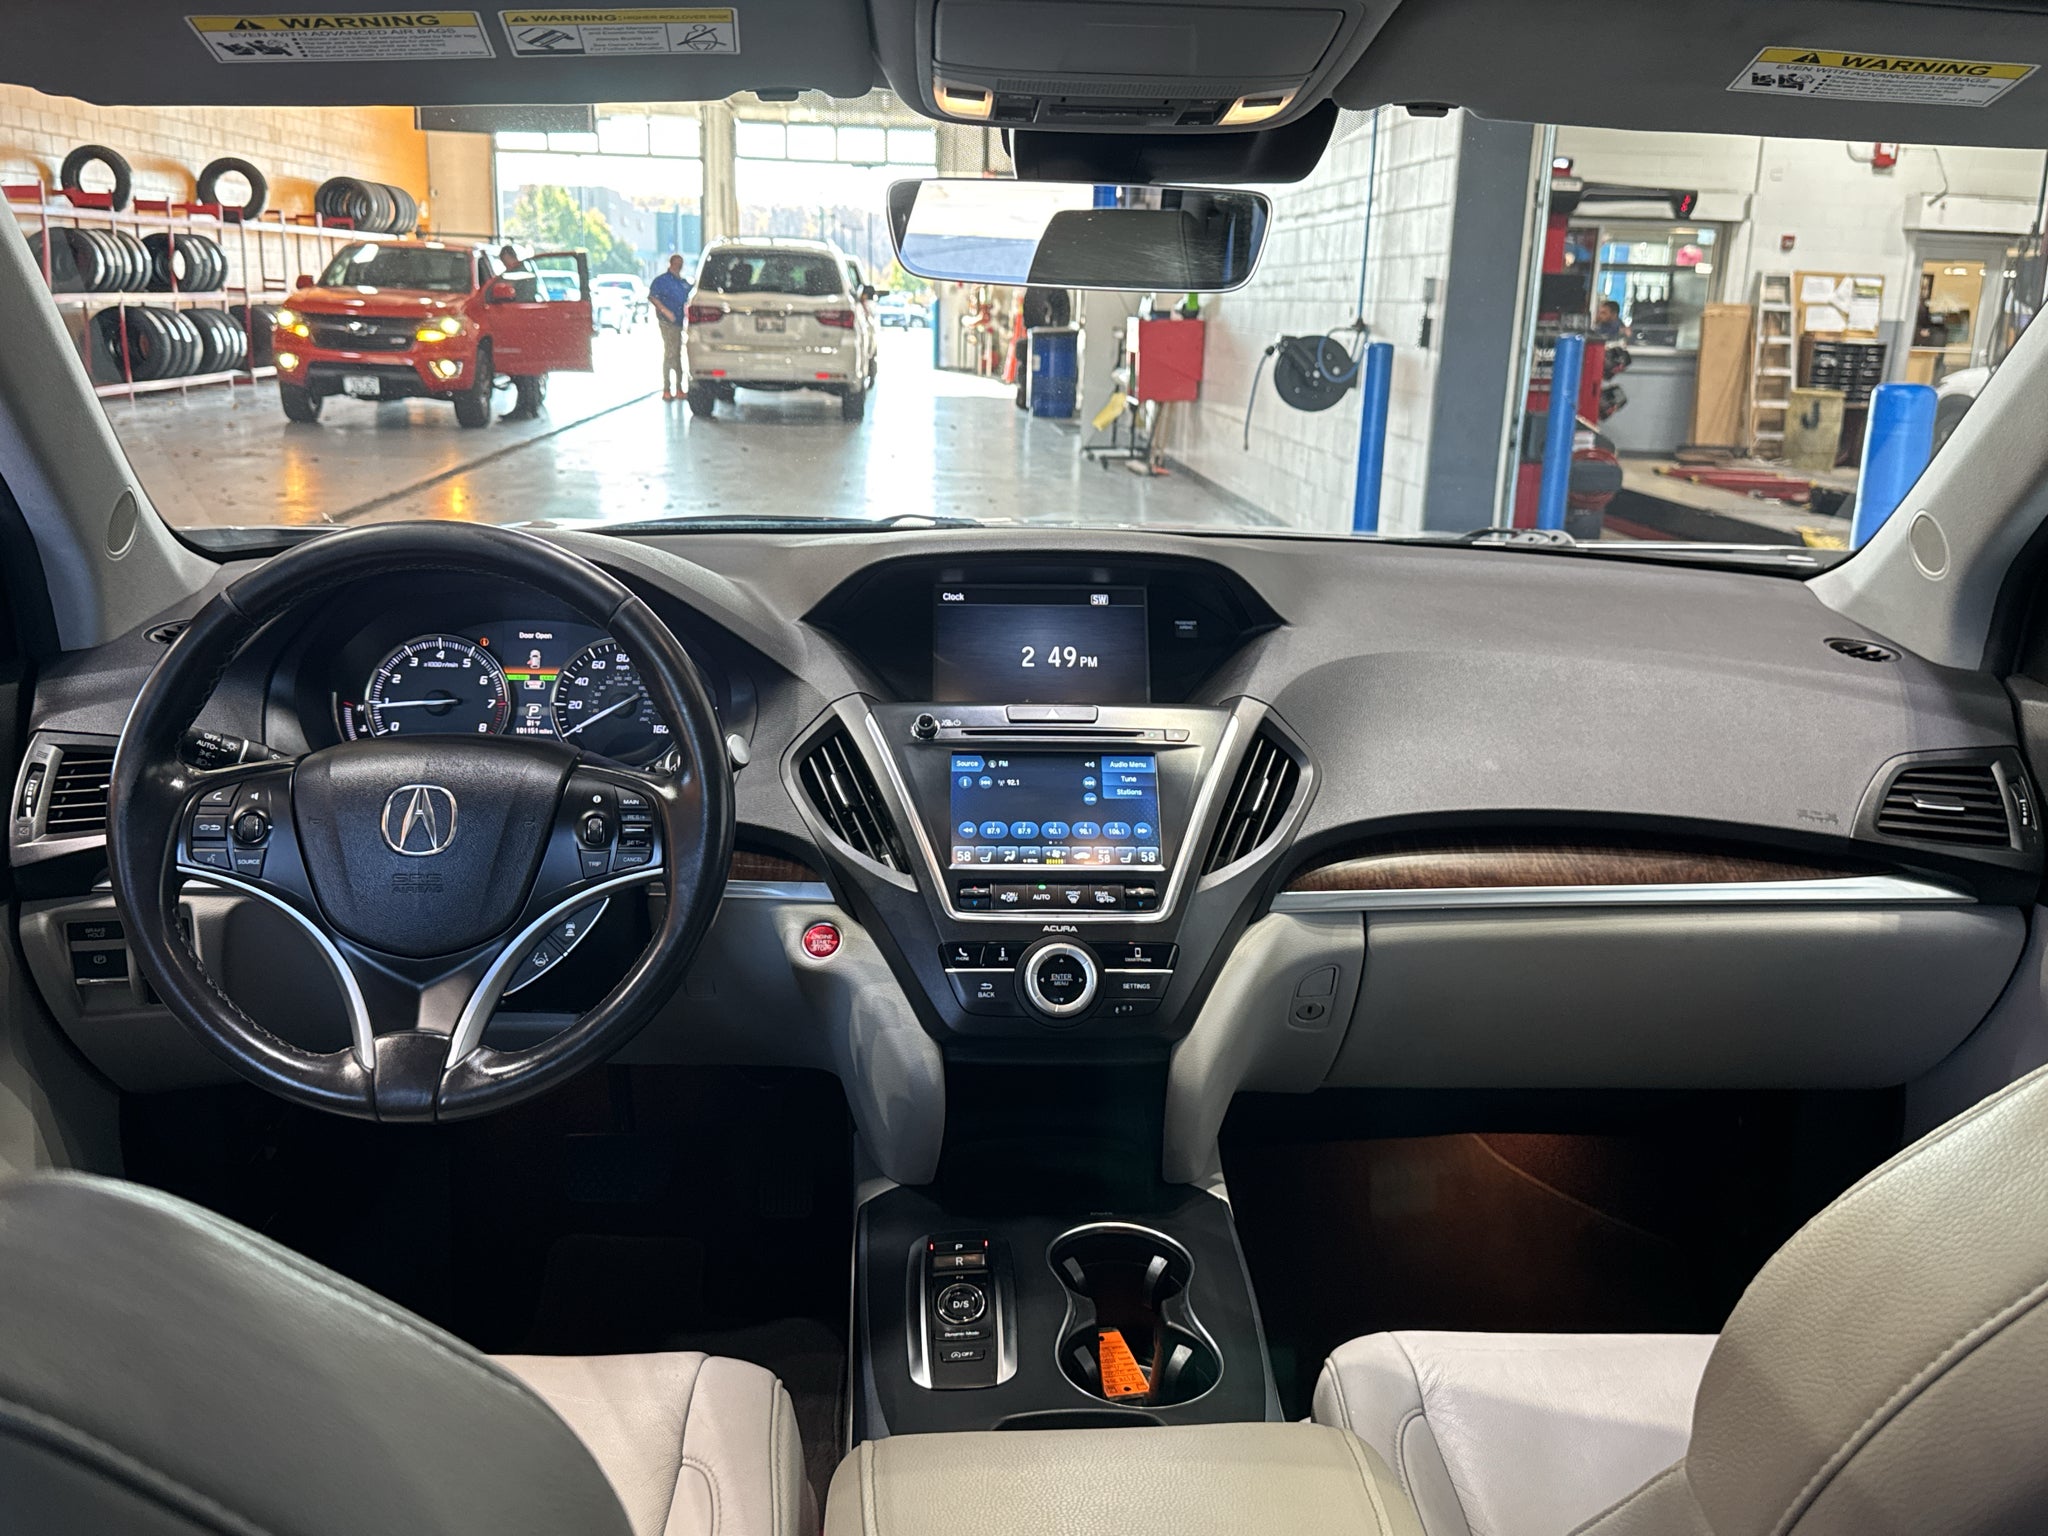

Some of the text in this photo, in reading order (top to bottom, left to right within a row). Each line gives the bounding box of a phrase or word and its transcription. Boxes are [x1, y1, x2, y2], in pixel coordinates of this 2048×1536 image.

[279, 15, 440, 29] WARNING
[311, 29, 387, 37] ADVANCED
[1842, 56, 1992, 76] WARNING
[1850, 70, 1925, 80] ADVANCED
[942, 592, 965, 601] Clock
[535, 632, 552, 640] Open
[436, 650, 445, 659] 4
[1021, 646, 1098, 667] 2 49 PM
[409, 657, 419, 667] 3
[462, 658, 471, 668] 5
[592, 660, 606, 669] 60
[391, 674, 401, 684] 2
[479, 675, 488, 685] 6
[575, 677, 589, 686] 40
[356, 704, 364, 712] H
[487, 699, 496, 709] 7
[568, 700, 582, 709] 20
[528, 706, 539, 716] P
[390, 722, 400, 731] 0
[478, 723, 487, 732] 8
[204, 732, 217, 741] OFF
[196, 739, 215, 750] AUTO
[1116, 788, 1142, 796] Stations
[957, 850, 972, 861] 58
[1098, 854, 1111, 863] 58
[1141, 851, 1156, 862] 58
[955, 1256, 964, 1266] R
[953, 1300, 970, 1309] D/S
